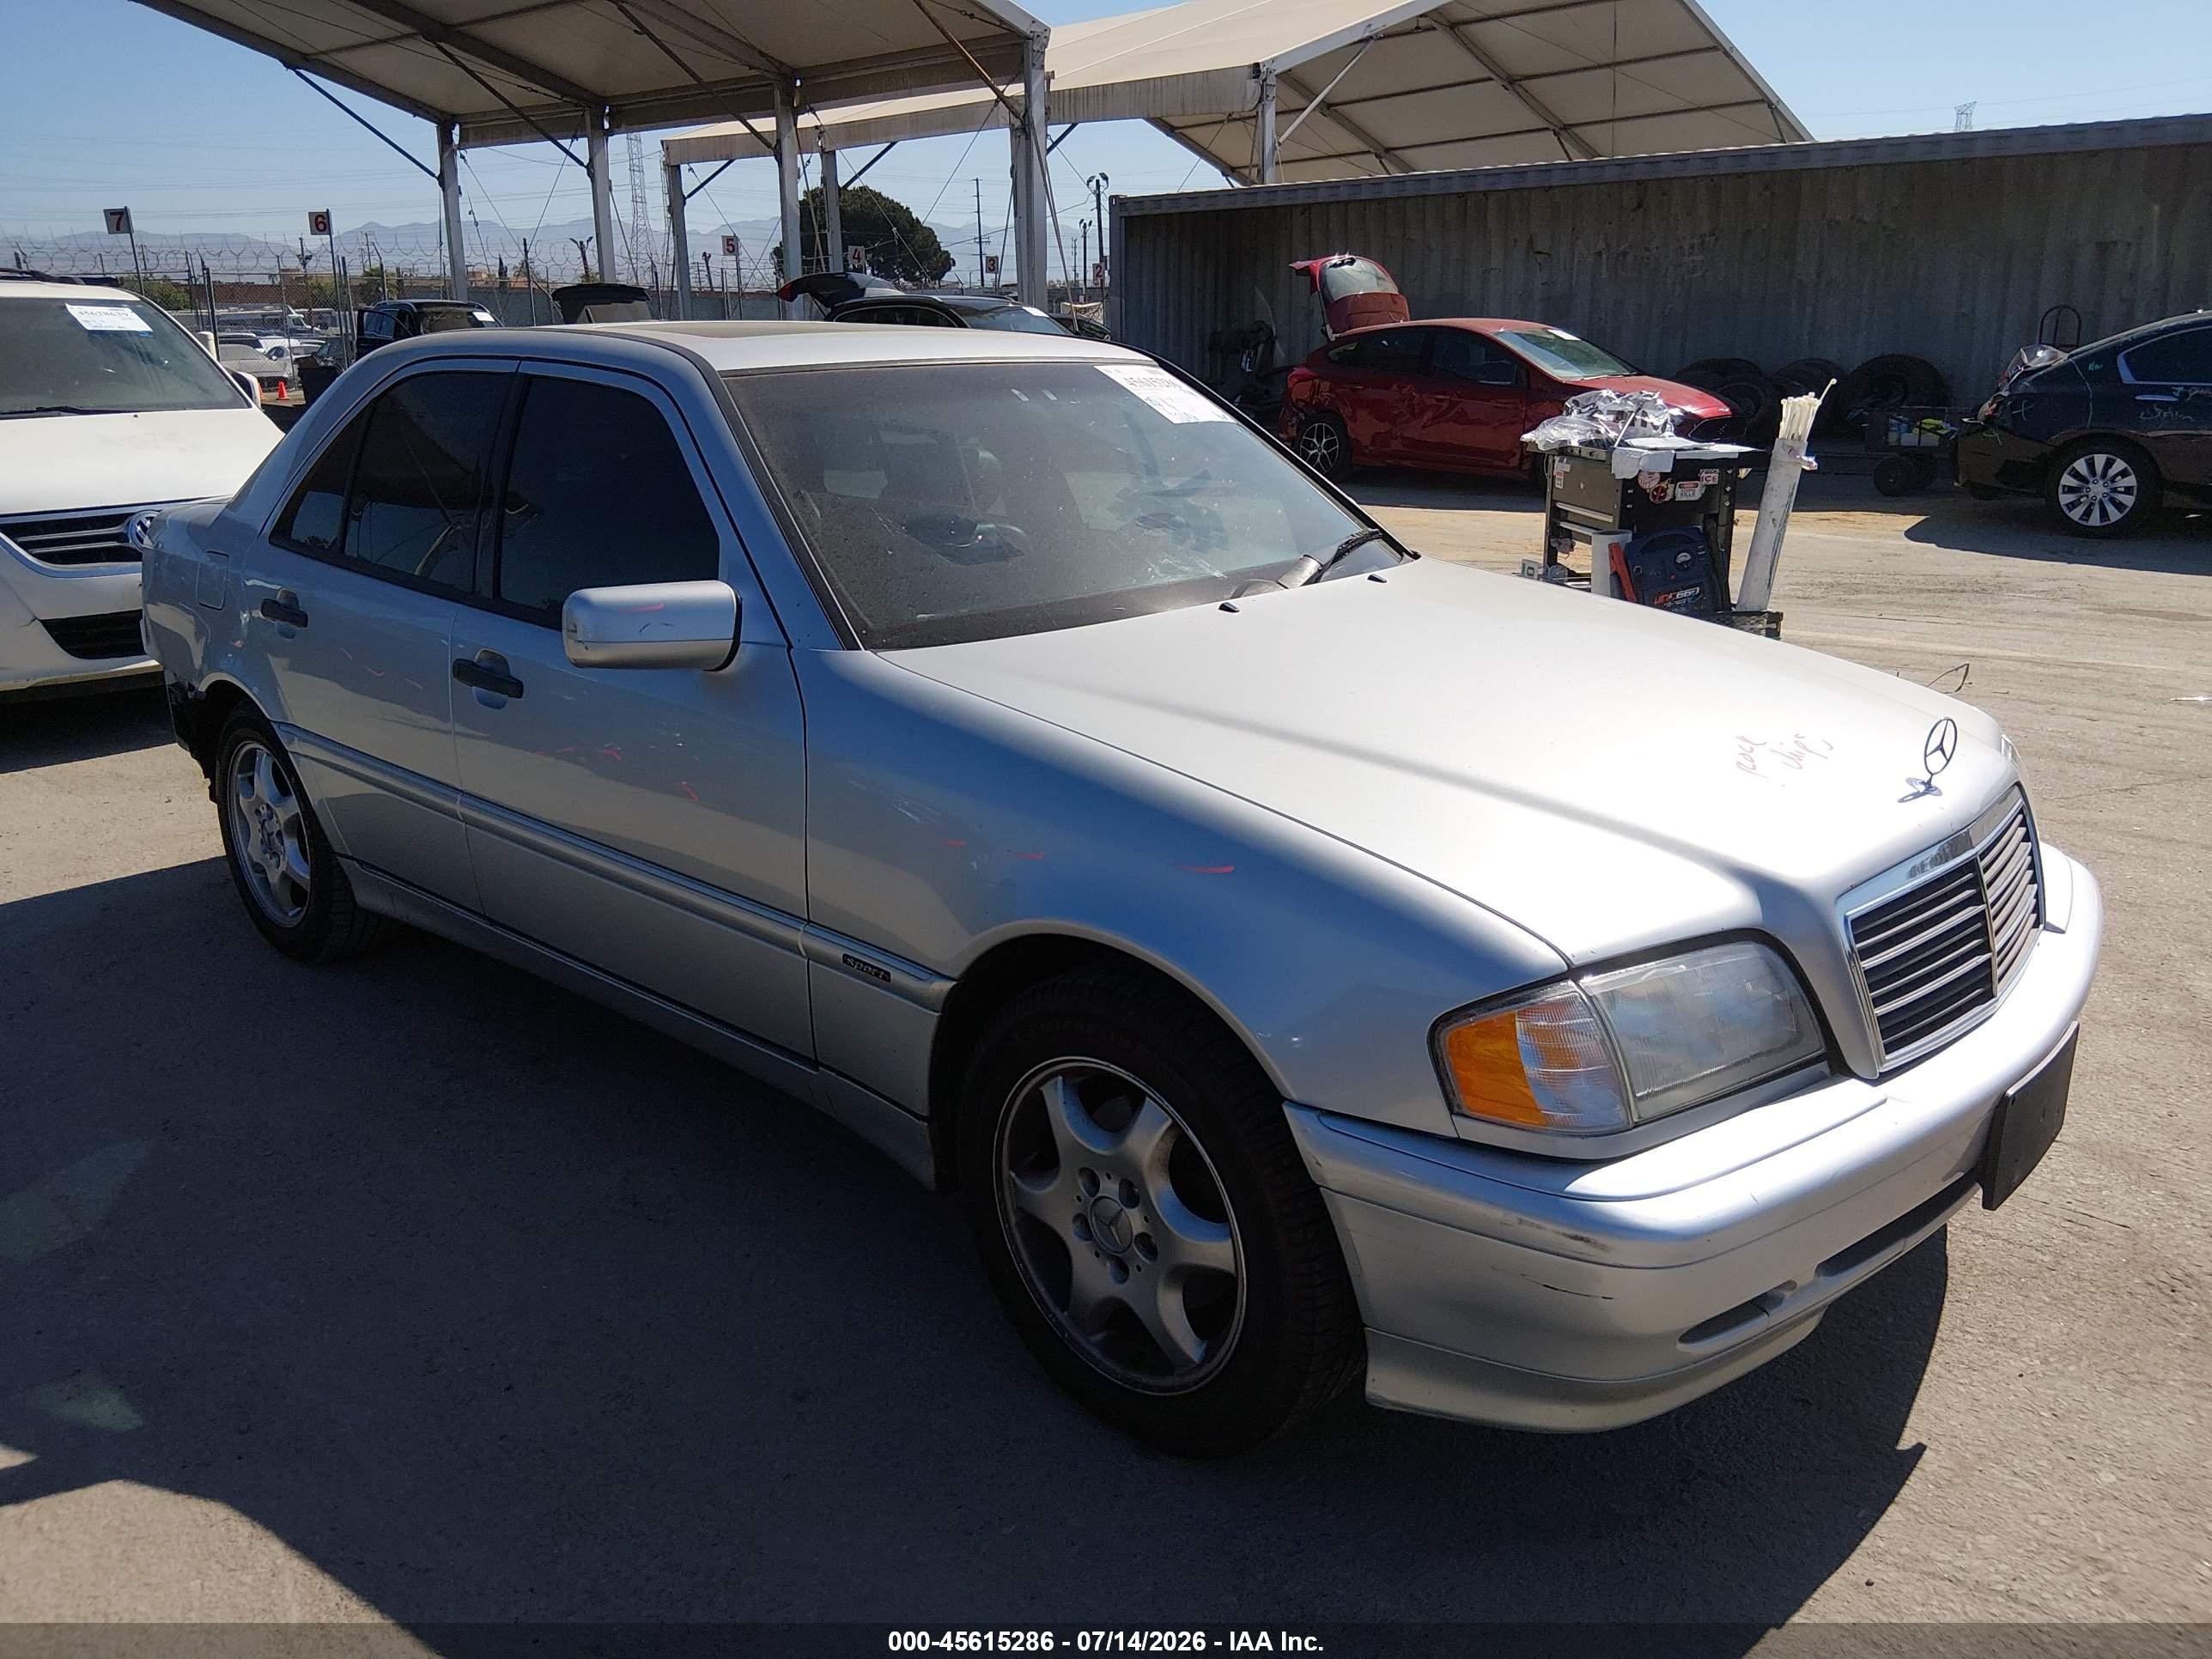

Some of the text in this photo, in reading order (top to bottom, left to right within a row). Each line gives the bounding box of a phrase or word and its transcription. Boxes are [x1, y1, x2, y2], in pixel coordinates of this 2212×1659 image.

[109, 210, 125, 232] 7
[314, 214, 328, 233] 6
[726, 238, 736, 254] 5
[851, 247, 862, 261] 4
[988, 258, 996, 272] 3
[1095, 264, 1103, 277] 2
